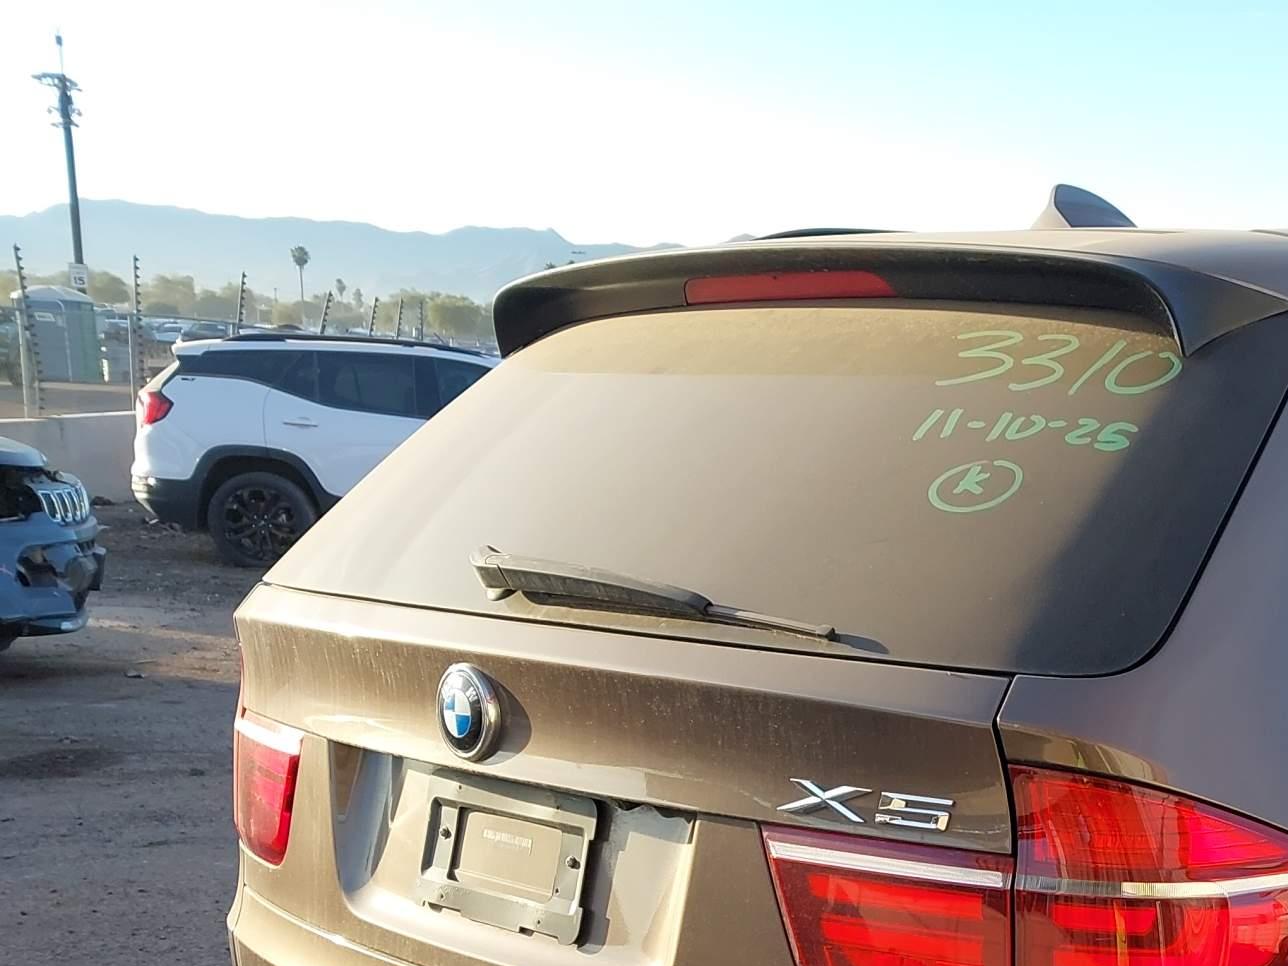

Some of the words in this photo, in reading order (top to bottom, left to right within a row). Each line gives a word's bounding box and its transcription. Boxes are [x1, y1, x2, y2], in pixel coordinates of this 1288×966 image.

[934, 329, 1184, 397] 3310
[911, 407, 1140, 452] 11-10-25
[776, 777, 956, 833] X5
